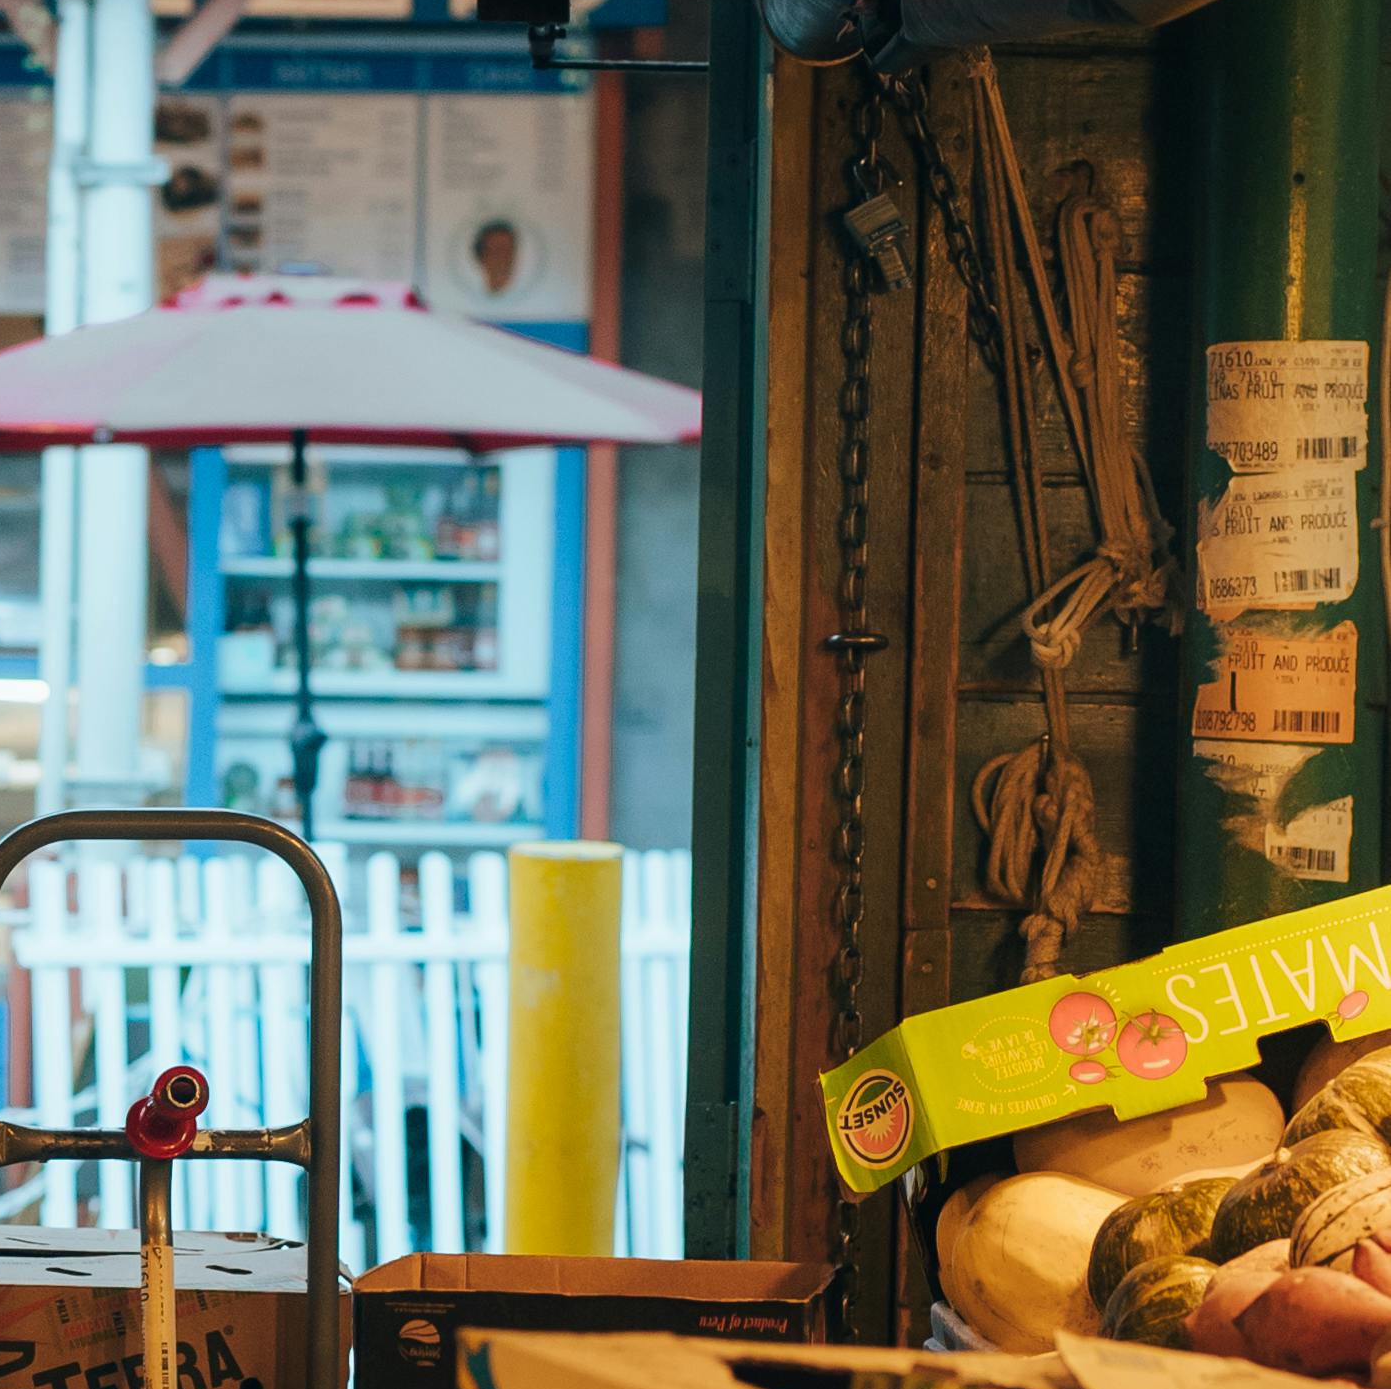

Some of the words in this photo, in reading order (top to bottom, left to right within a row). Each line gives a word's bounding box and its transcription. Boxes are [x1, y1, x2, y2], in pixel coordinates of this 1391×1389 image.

[1209, 350, 1253, 368] 71610
[1240, 370, 1279, 384] 71610
[1208, 382, 1240, 402] LINAS
[1246, 382, 1286, 400] FRUIT
[1324, 381, 1364, 400] PRODUCE
[1224, 517, 1262, 536] FRUIT
[1269, 515, 1294, 532] AND
[1300, 511, 1349, 530] PRODUCE
[1227, 652, 1266, 671] FRUIT
[1272, 654, 1299, 672] AND
[1305, 654, 1351, 674] PRODUCE
[1005, 1032, 1019, 1048] LA
[1029, 1039, 1050, 1056] LES
[980, 1045, 1028, 1068] SAVEURS
[839, 1079, 907, 1131] SUNSET
[954, 1095, 986, 1114] SERRE
[989, 1102, 1004, 1116] EN
[697, 1315, 727, 1333] Peru
[728, 1314, 742, 1333] of
[742, 1316, 789, 1334] Product
